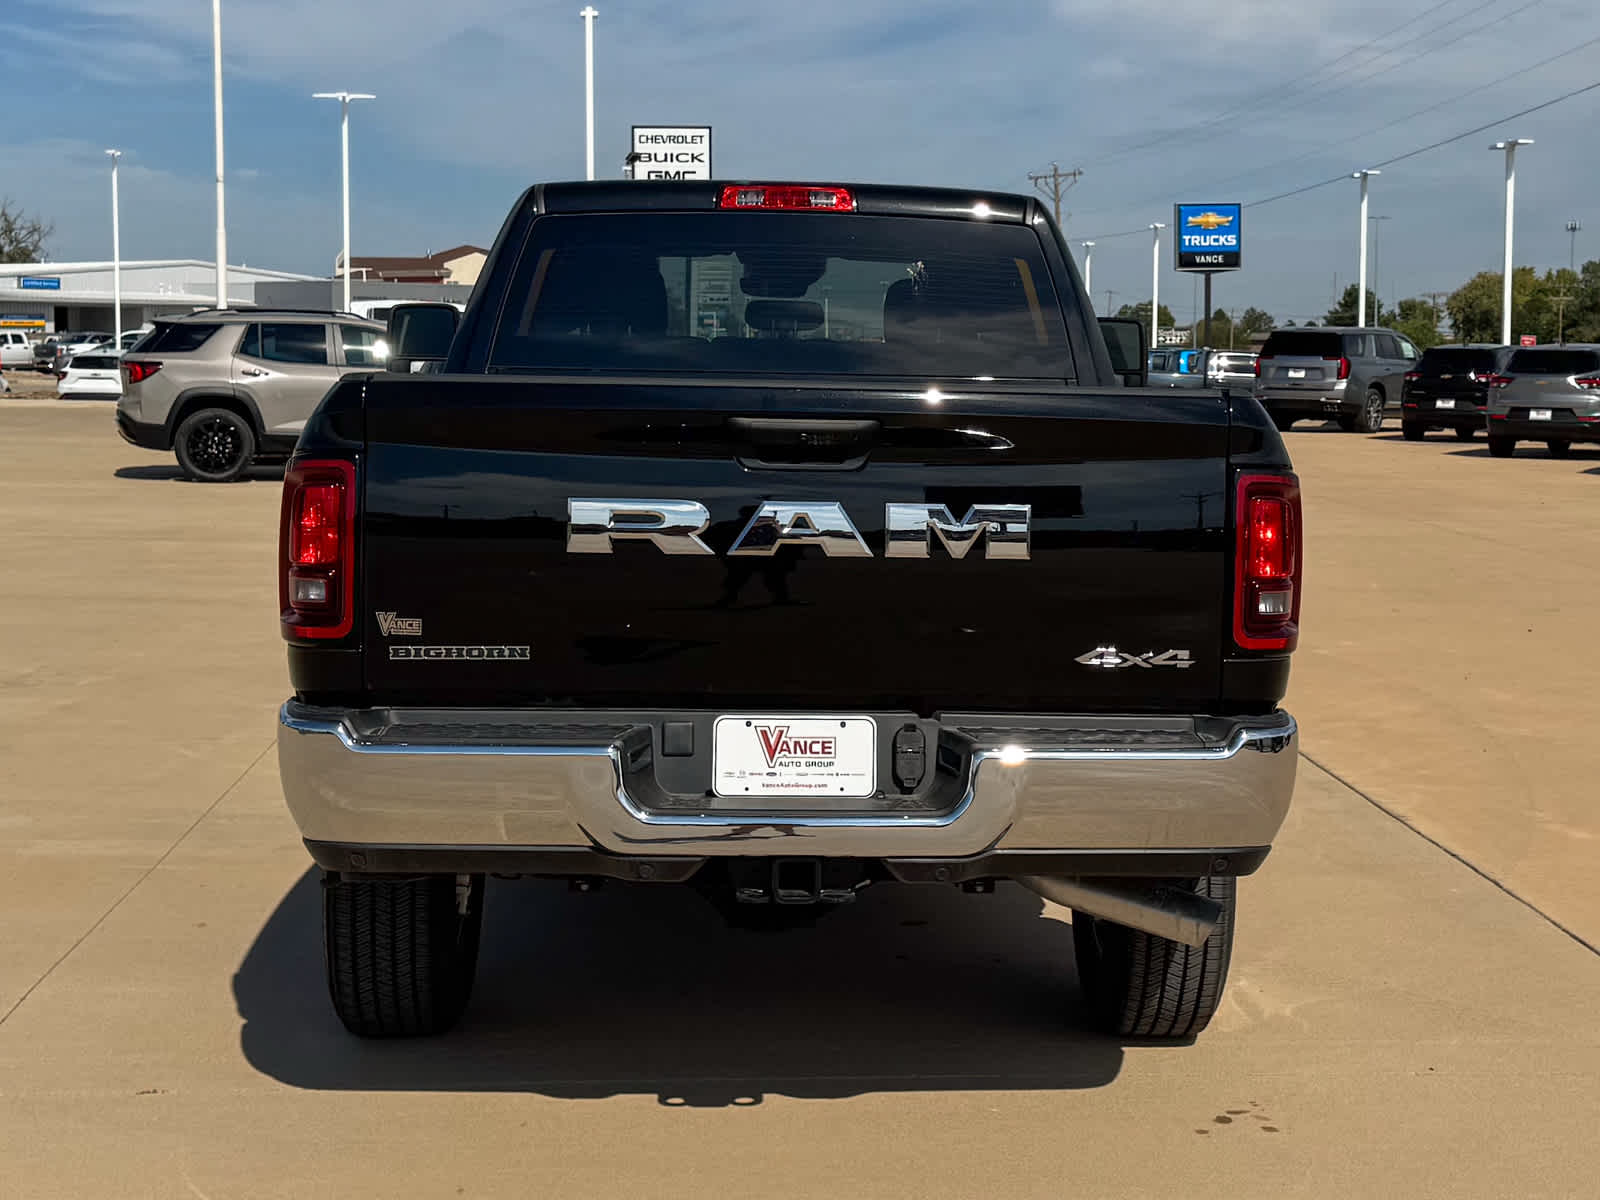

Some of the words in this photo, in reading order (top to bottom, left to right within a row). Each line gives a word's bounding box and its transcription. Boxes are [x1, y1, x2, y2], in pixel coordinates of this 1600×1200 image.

[638, 134, 705, 145] CHEVROLET
[638, 152, 705, 163] BUICK
[647, 170, 697, 181] GMC
[1182, 234, 1237, 246] TRUCKS
[1194, 254, 1225, 264] VANCE
[566, 497, 1032, 560] RAM
[389, 645, 531, 660] BIGHORN
[1073, 646, 1197, 669] 4x4
[778, 760, 802, 768] AUTO
[804, 760, 835, 768] GROUP
